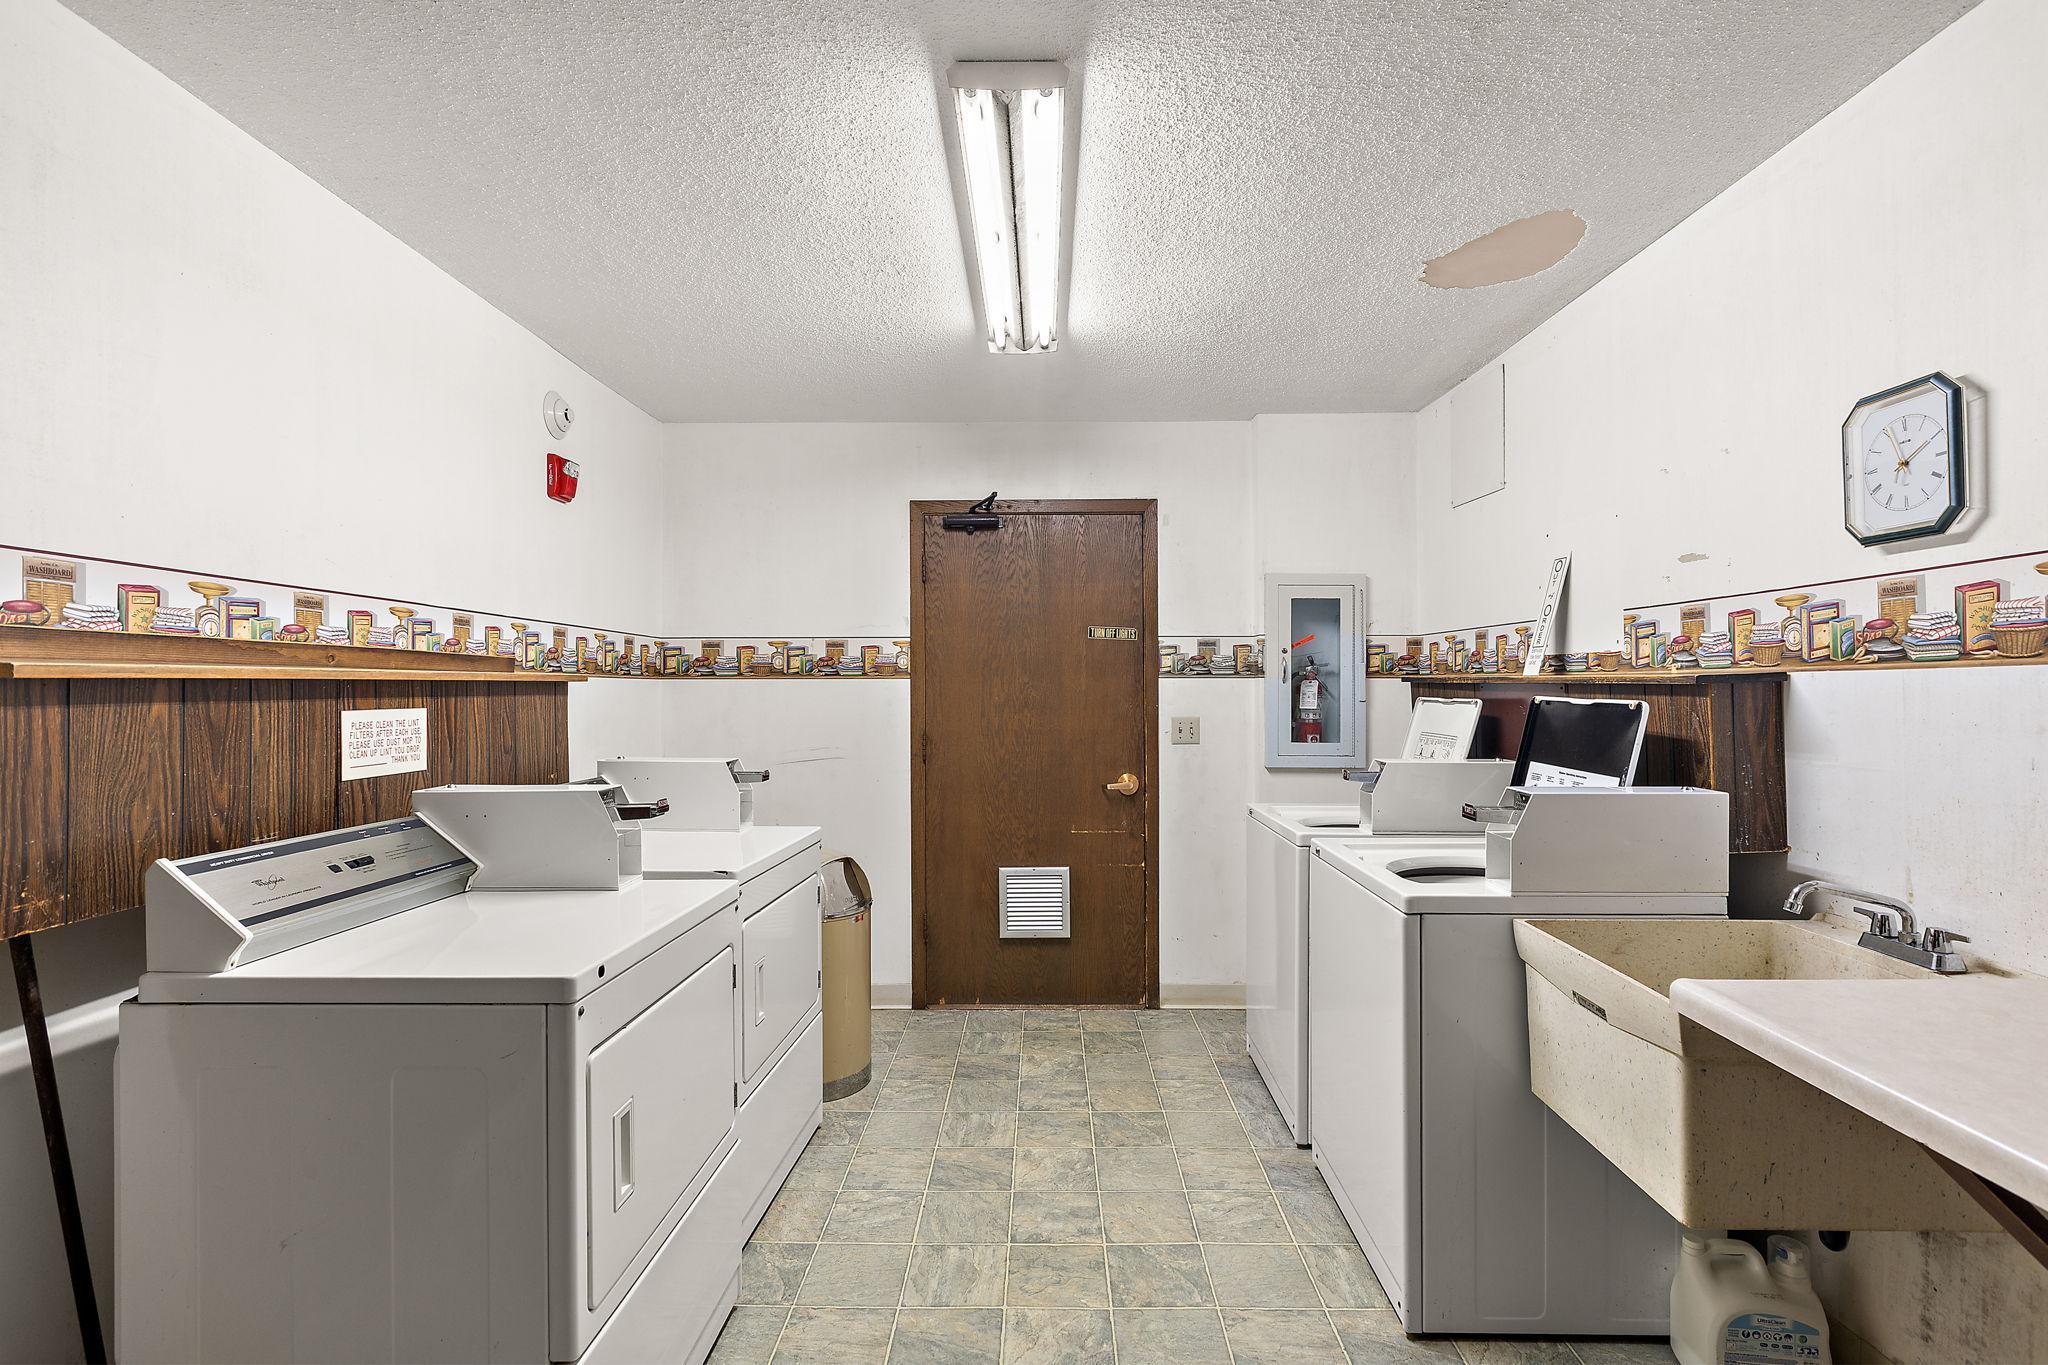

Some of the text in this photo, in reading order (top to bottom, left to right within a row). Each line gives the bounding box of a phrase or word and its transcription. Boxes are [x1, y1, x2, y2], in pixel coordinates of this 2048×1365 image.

[28, 565, 72, 577] WASHBOARD
[1881, 584, 1914, 594] WASHBOARD
[1091, 628, 1135, 639] TURN OFF LIGHTS
[352, 721, 374, 730] PLEASE
[376, 720, 393, 728] CLEAN
[408, 718, 420, 727] LINT
[350, 730, 374, 739] FILTERS
[376, 729, 393, 737] AFTER
[395, 728, 408, 736] EACH
[348, 740, 371, 750] PLEASE
[374, 739, 384, 747] USE
[386, 738, 400, 746] DUST
[403, 736, 413, 744] MOP
[349, 750, 368, 759] CLEAN
[370, 749, 378, 757] UP
[380, 748, 392, 756] LINT
[394, 746, 404, 754] YOU
[392, 755, 408, 763] THANK
